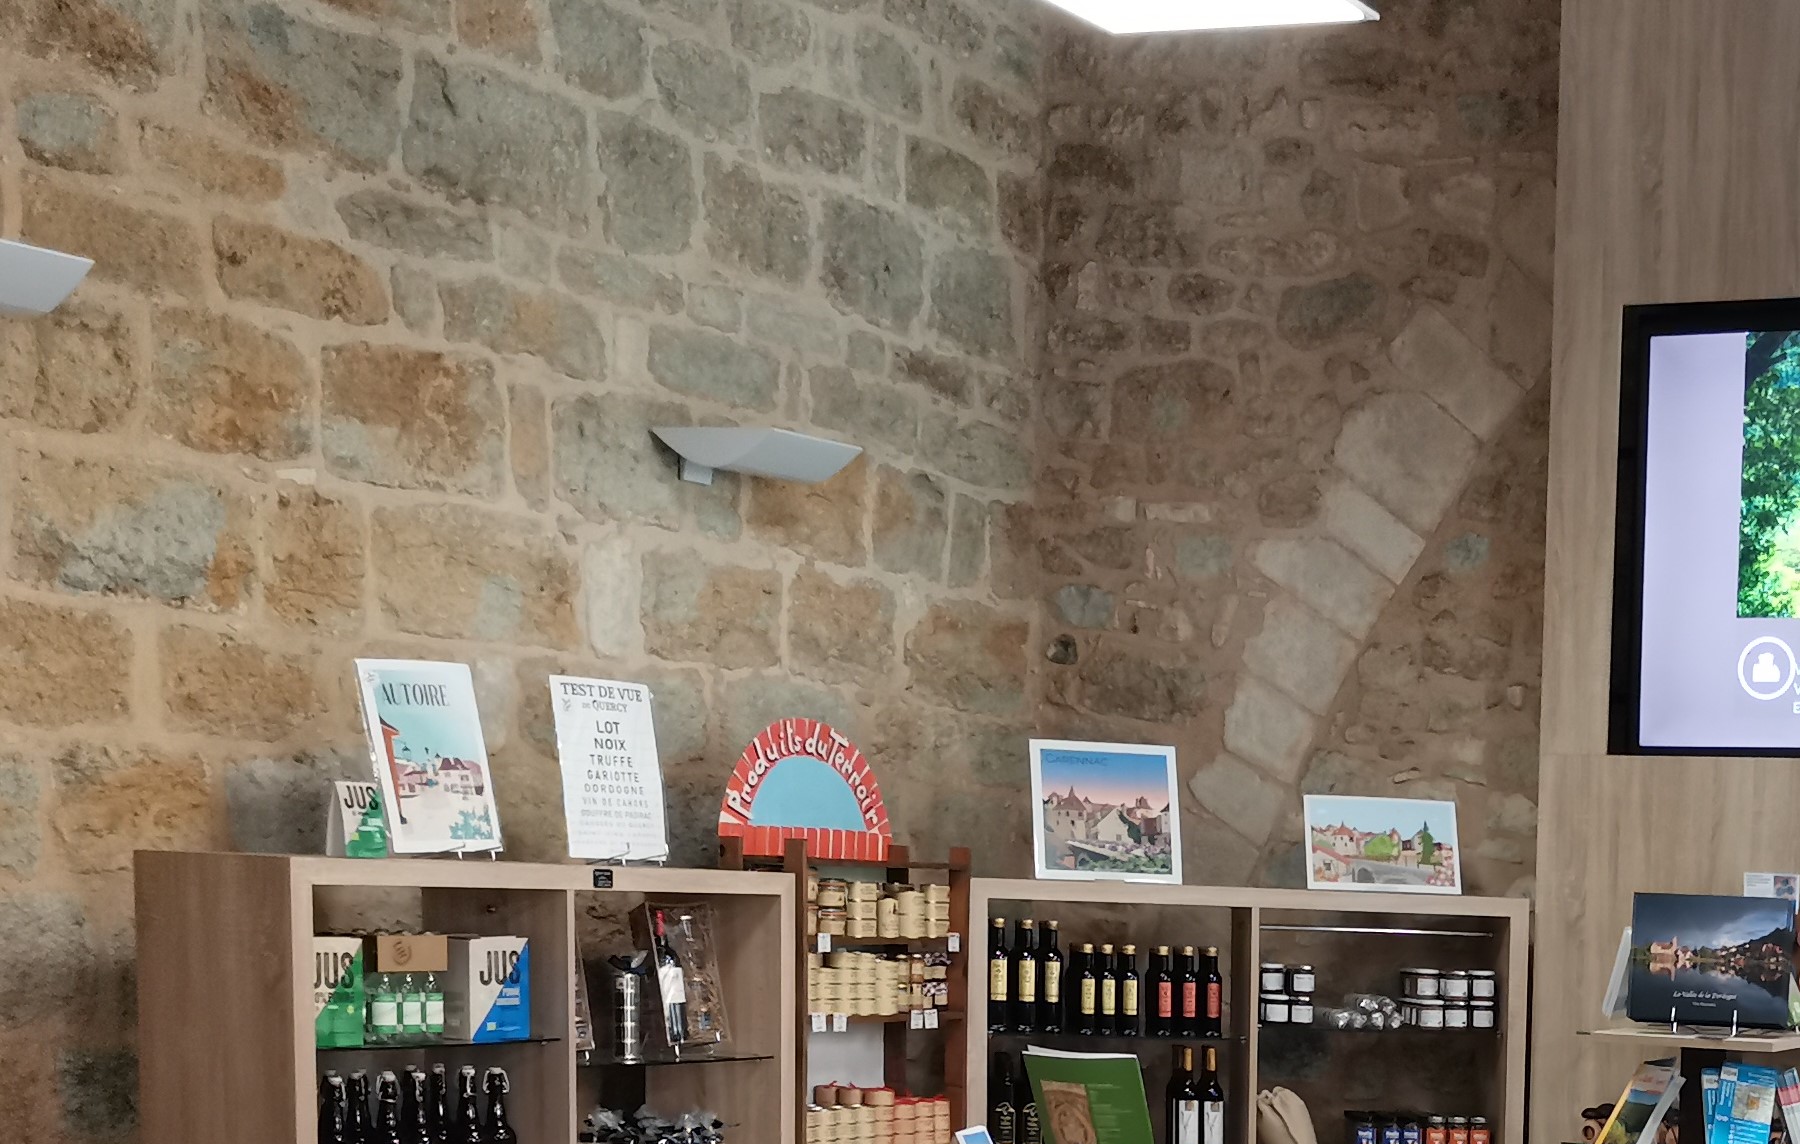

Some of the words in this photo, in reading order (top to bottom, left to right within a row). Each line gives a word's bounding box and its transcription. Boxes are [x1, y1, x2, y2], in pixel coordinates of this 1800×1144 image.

[381, 682, 450, 708] AUTOIRE
[560, 682, 596, 698] TEST
[598, 684, 616, 700] DE
[616, 687, 643, 703] VUE
[592, 699, 628, 713] QUERCY
[596, 720, 621, 735] LOT
[594, 737, 627, 752] NOIX
[589, 753, 634, 768] TRUFFE
[586, 769, 641, 783] GARIOTTE
[726, 720, 802, 820] Produits
[805, 722, 828, 760] du
[828, 728, 879, 825] Terroir
[344, 784, 380, 812] JUS
[584, 784, 645, 796] DORDOGNE
[313, 951, 355, 990] JUS
[479, 950, 521, 986] JUS
